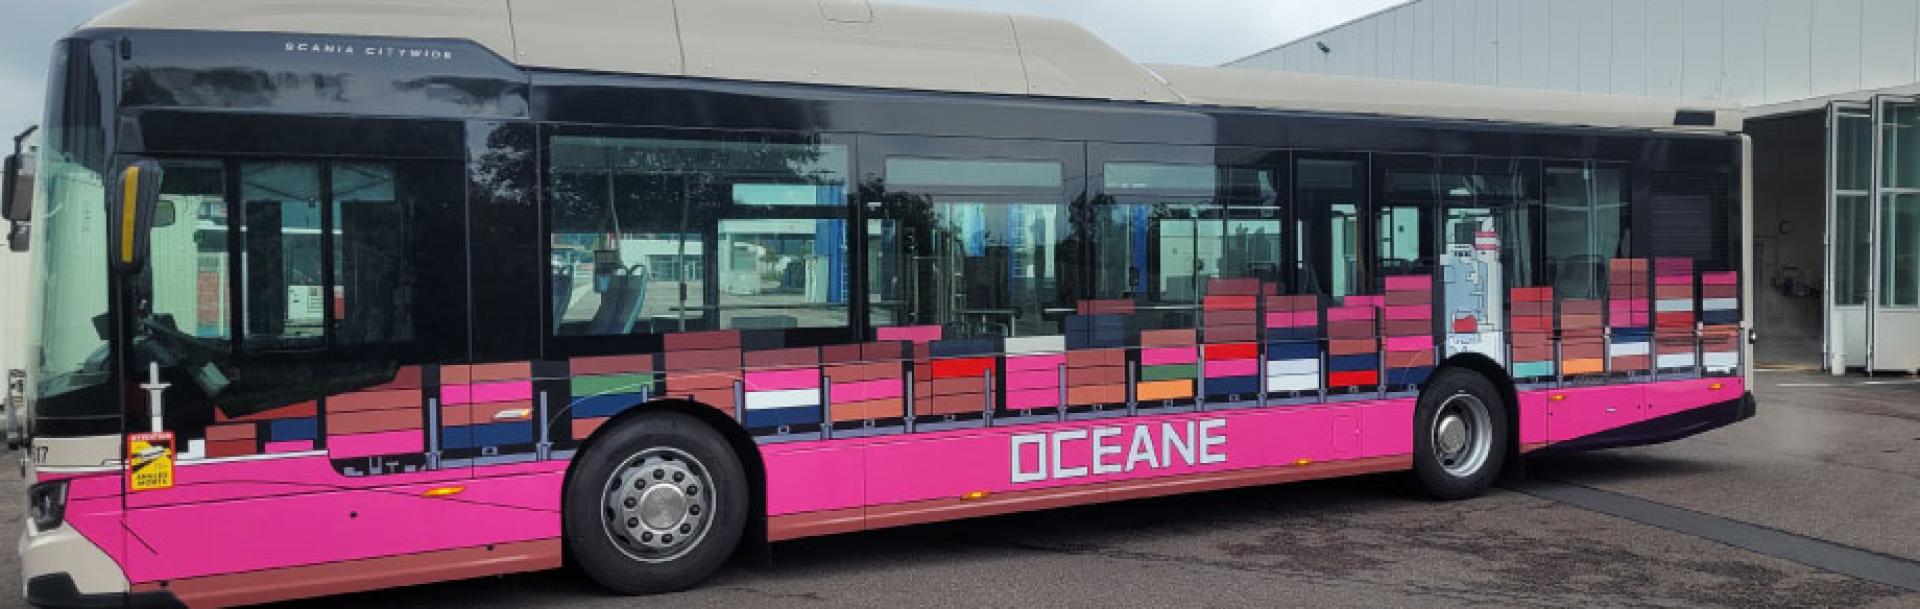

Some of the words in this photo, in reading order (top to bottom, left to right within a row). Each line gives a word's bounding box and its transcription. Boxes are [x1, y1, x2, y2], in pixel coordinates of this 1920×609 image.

[285, 42, 354, 54] SCANIA
[365, 47, 452, 60] CITYWIDE
[1011, 418, 1227, 483] OCEANE
